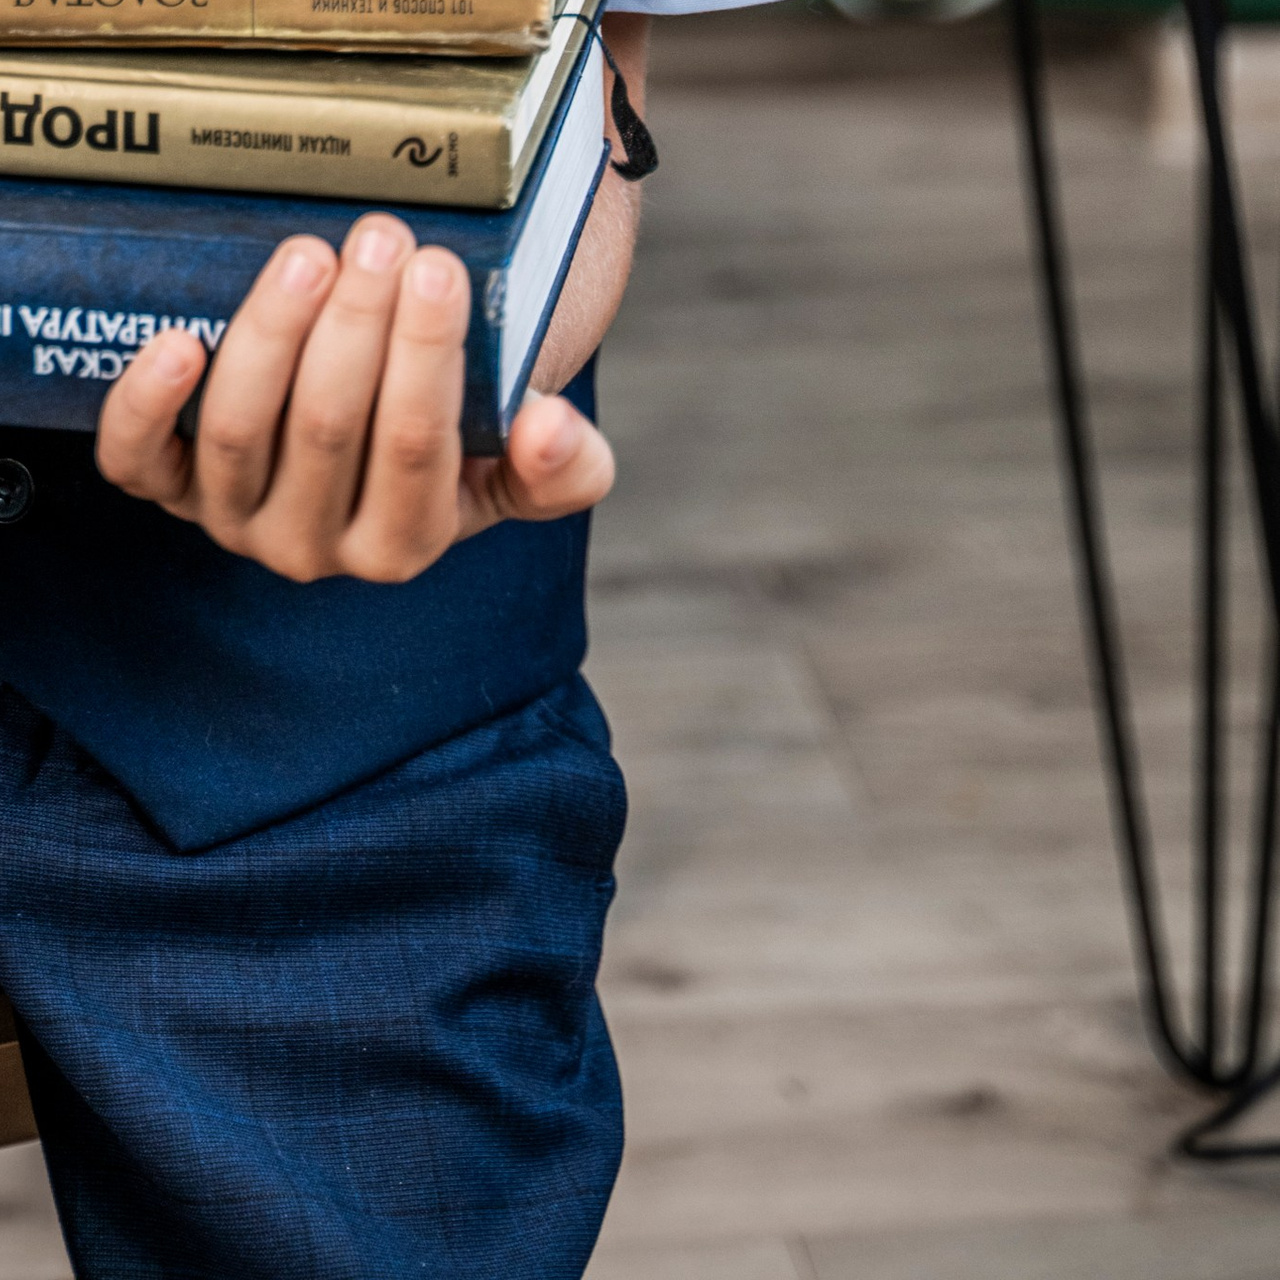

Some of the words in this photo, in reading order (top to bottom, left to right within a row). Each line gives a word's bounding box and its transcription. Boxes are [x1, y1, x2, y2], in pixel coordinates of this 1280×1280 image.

[191, 128, 293, 152] ПИНТОСЕВИЧ
[299, 134, 351, 156] ИЦХАК
[32, 344, 136, 381] СКАЯ
